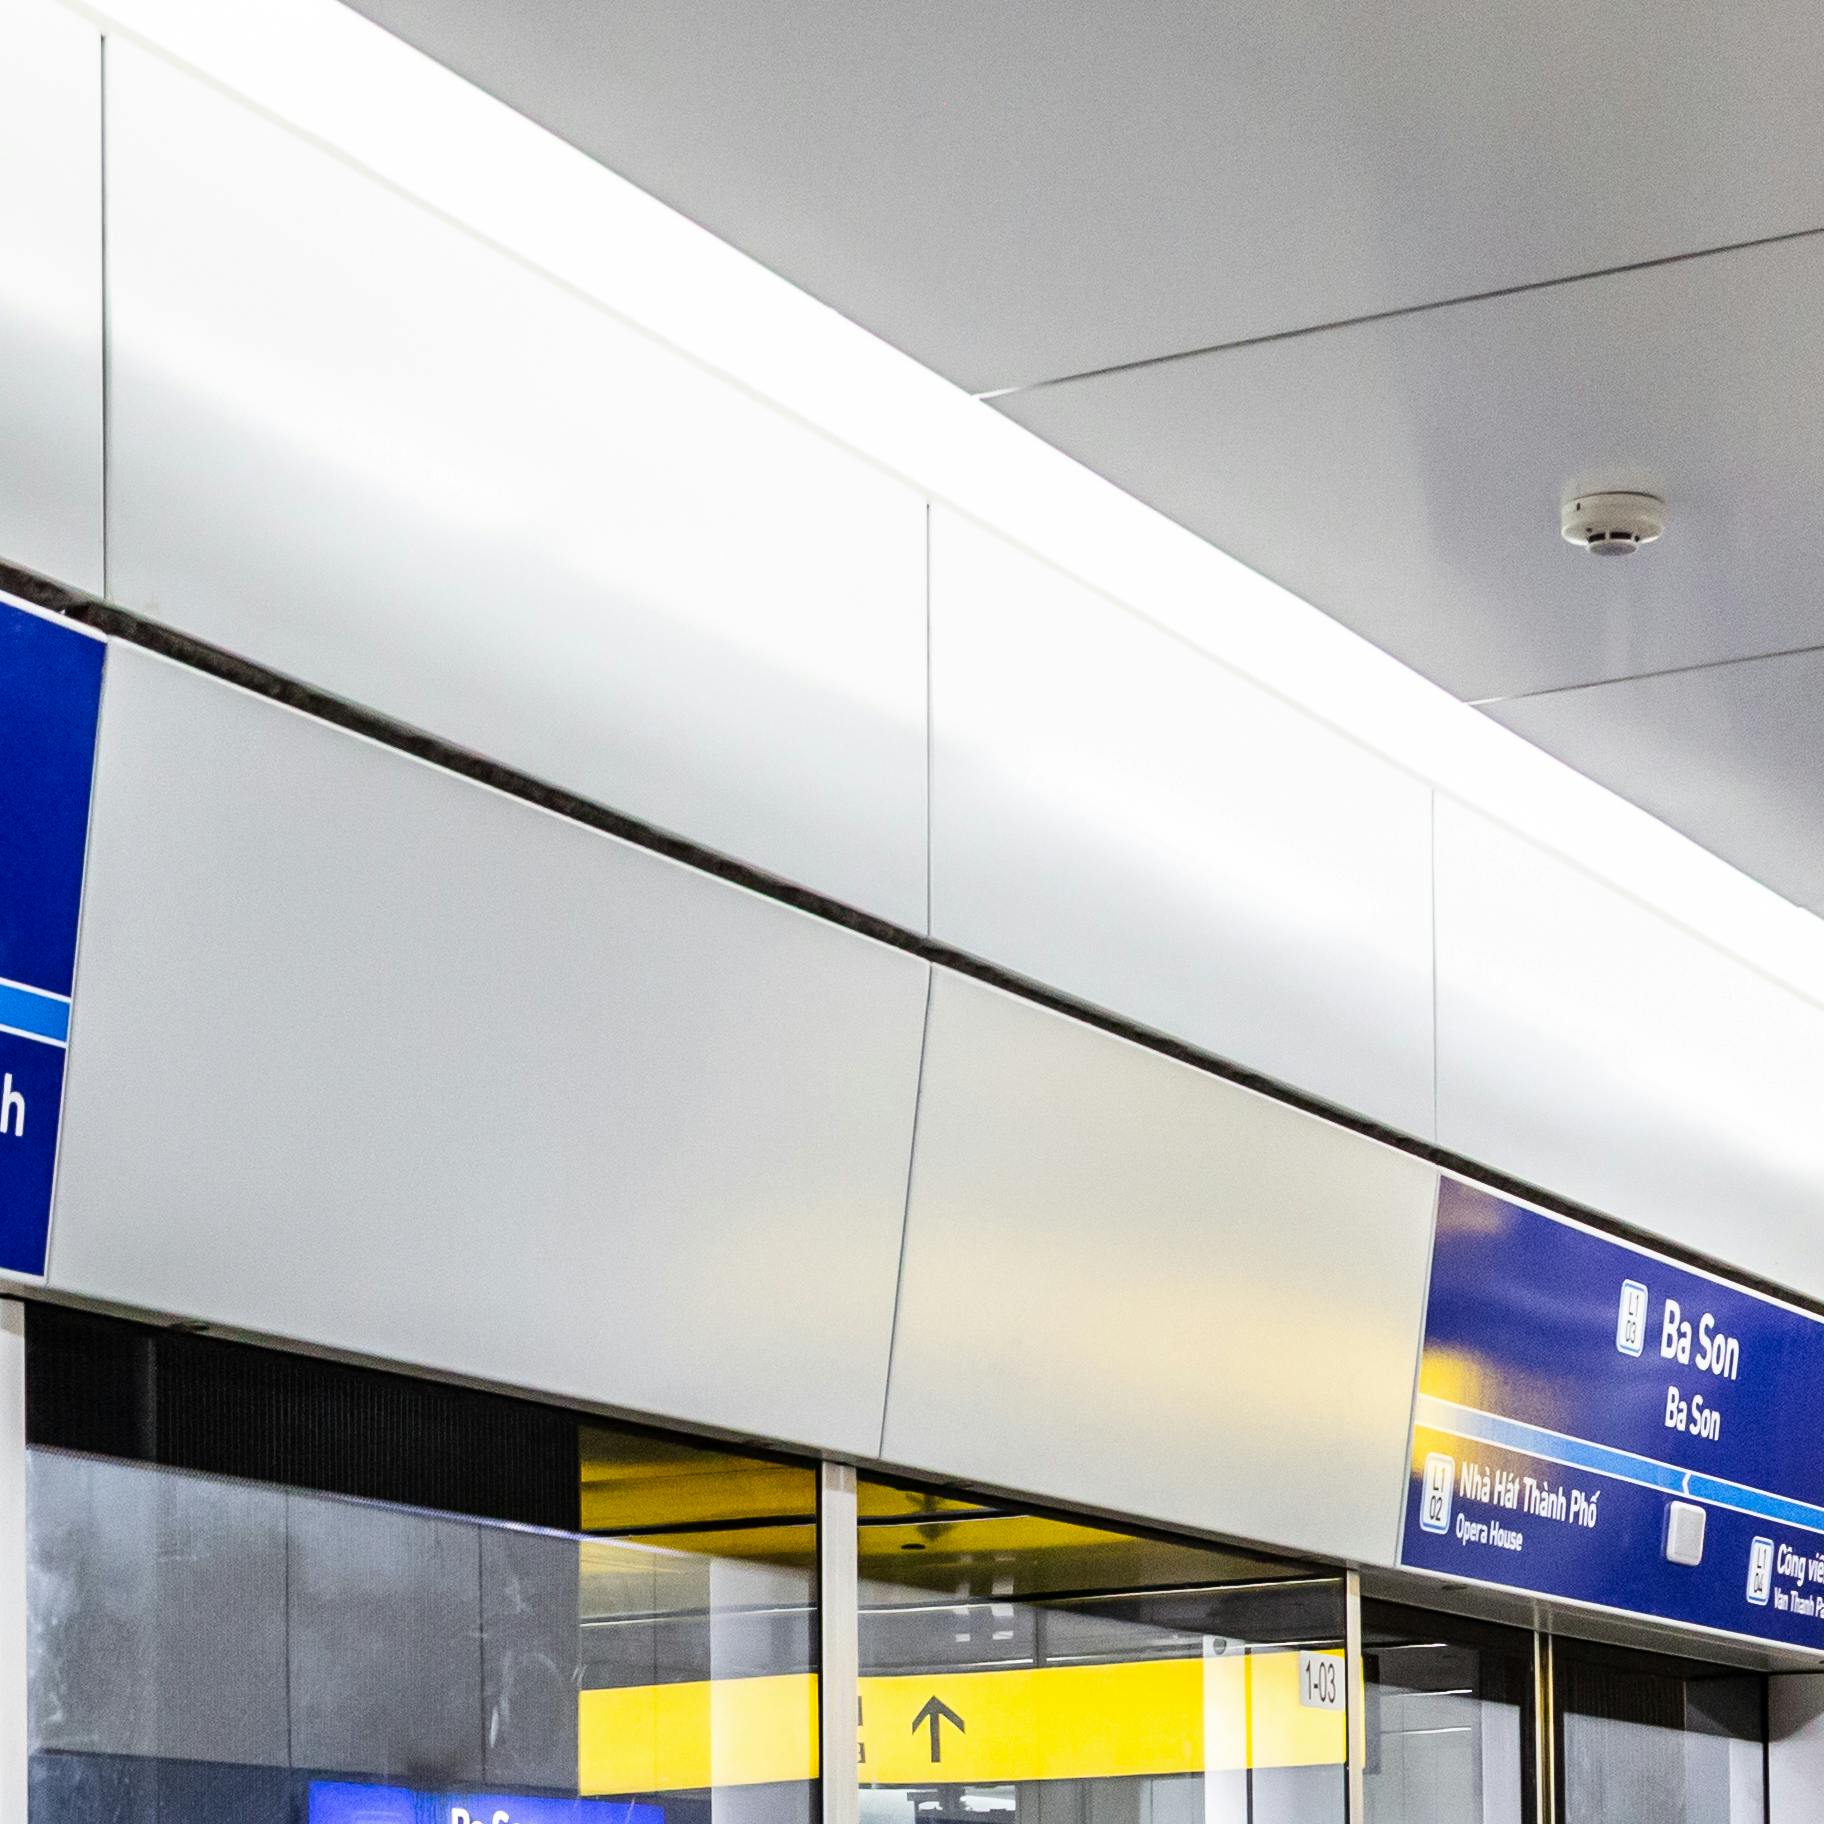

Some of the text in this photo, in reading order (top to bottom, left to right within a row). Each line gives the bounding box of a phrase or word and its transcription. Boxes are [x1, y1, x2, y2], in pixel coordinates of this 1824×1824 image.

[1660, 1298, 1740, 1381] Ba Son
[1664, 1385, 1721, 1441] Ba Son
[1432, 1466, 1446, 1492] L1
[1459, 1461, 1601, 1529] Nhà Hát Thành Phố
[1429, 1495, 1444, 1522] 02
[1455, 1512, 1523, 1551] Opera House
[1777, 1543, 1807, 1587] Công
[1306, 1659, 1336, 1704] 1-03
